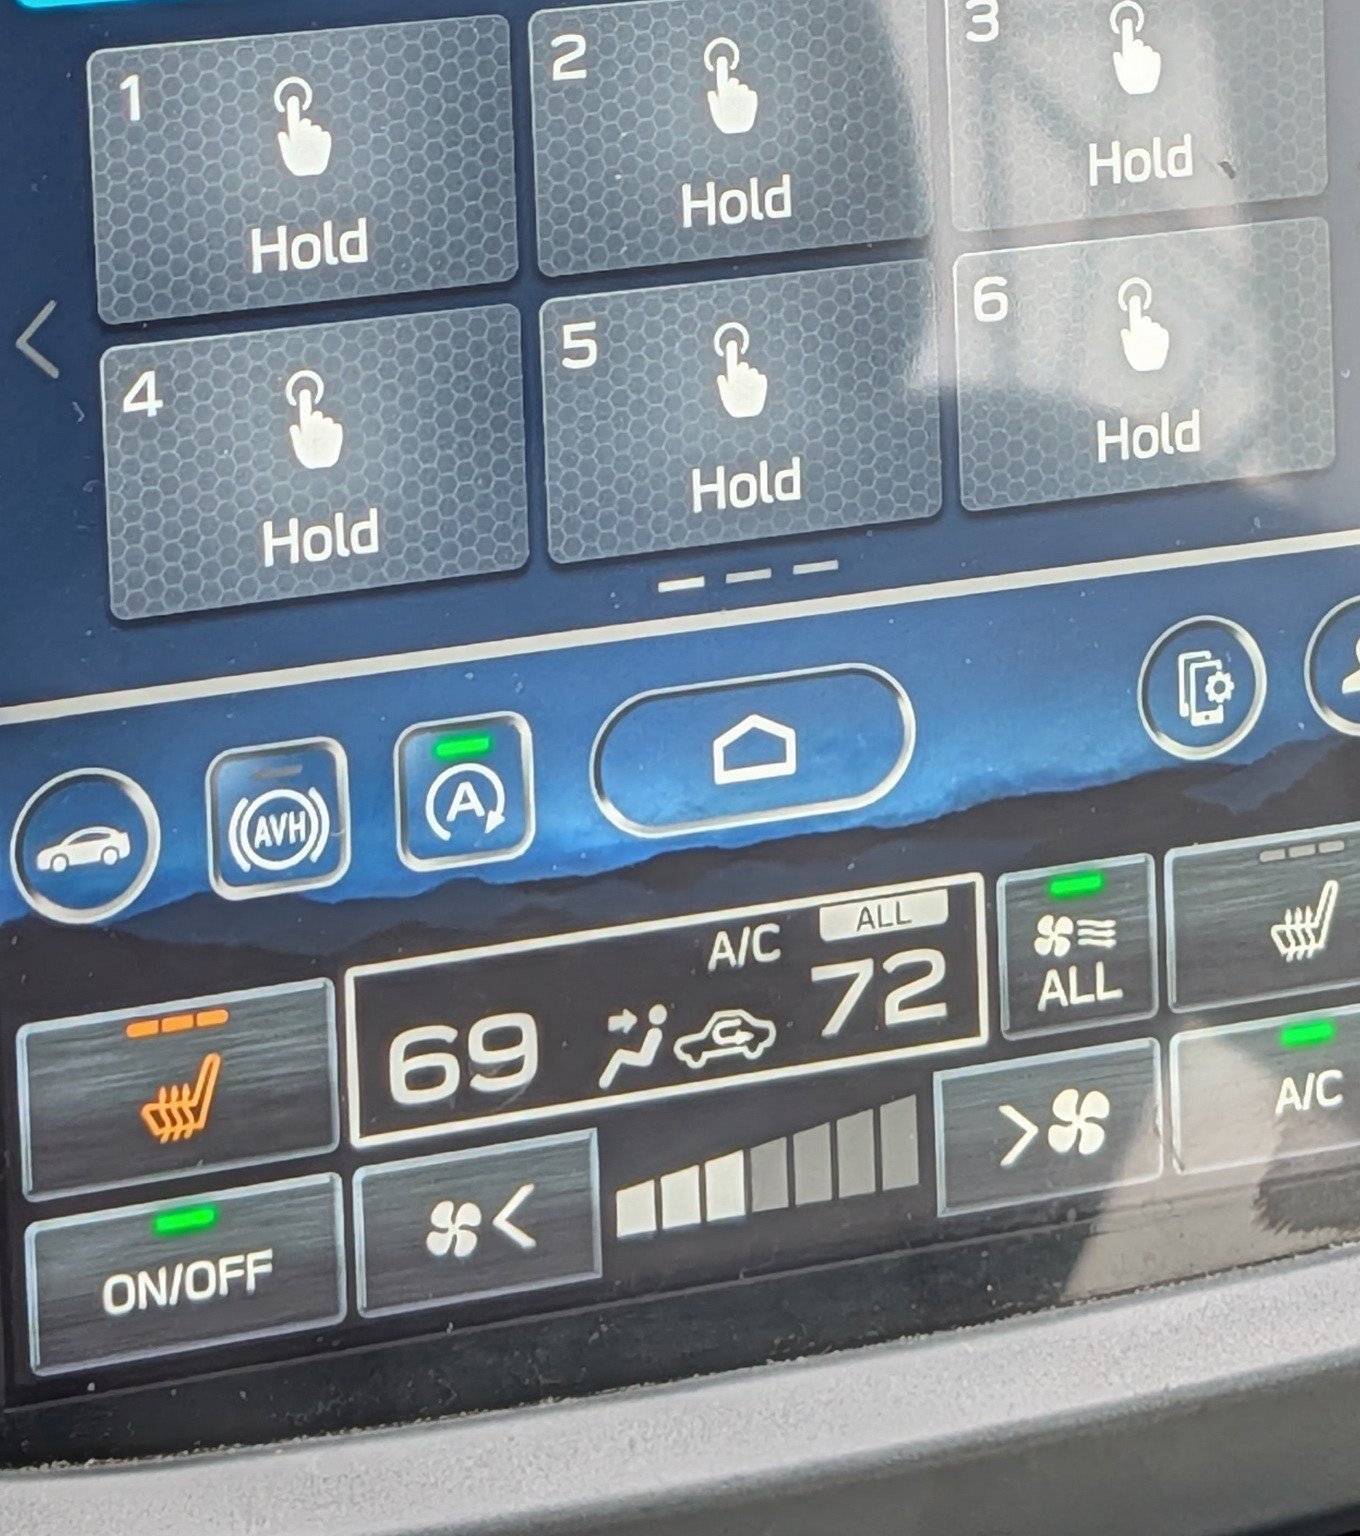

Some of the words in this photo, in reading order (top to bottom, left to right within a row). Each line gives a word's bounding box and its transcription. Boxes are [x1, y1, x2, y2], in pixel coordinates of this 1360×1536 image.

[550, 31, 588, 83] 2
[118, 73, 142, 124] 1
[1087, 132, 1195, 188] Hold
[680, 173, 794, 230] Hold
[250, 216, 370, 275] Hold
[972, 275, 1009, 324] 6
[560, 320, 599, 371] 5
[121, 368, 164, 419] 4
[1095, 408, 1202, 465] Hold
[690, 455, 803, 514] Hold
[261, 506, 381, 569] Hold
[445, 783, 488, 824] A
[252, 809, 307, 851] AVH
[854, 899, 914, 933] ALL
[706, 922, 783, 975] A/C
[809, 947, 950, 1040] 72
[1036, 962, 1125, 1013] ALL
[387, 1011, 540, 1107] 69
[1273, 1068, 1345, 1117] A/C
[100, 1248, 276, 1318] ON/OFF
